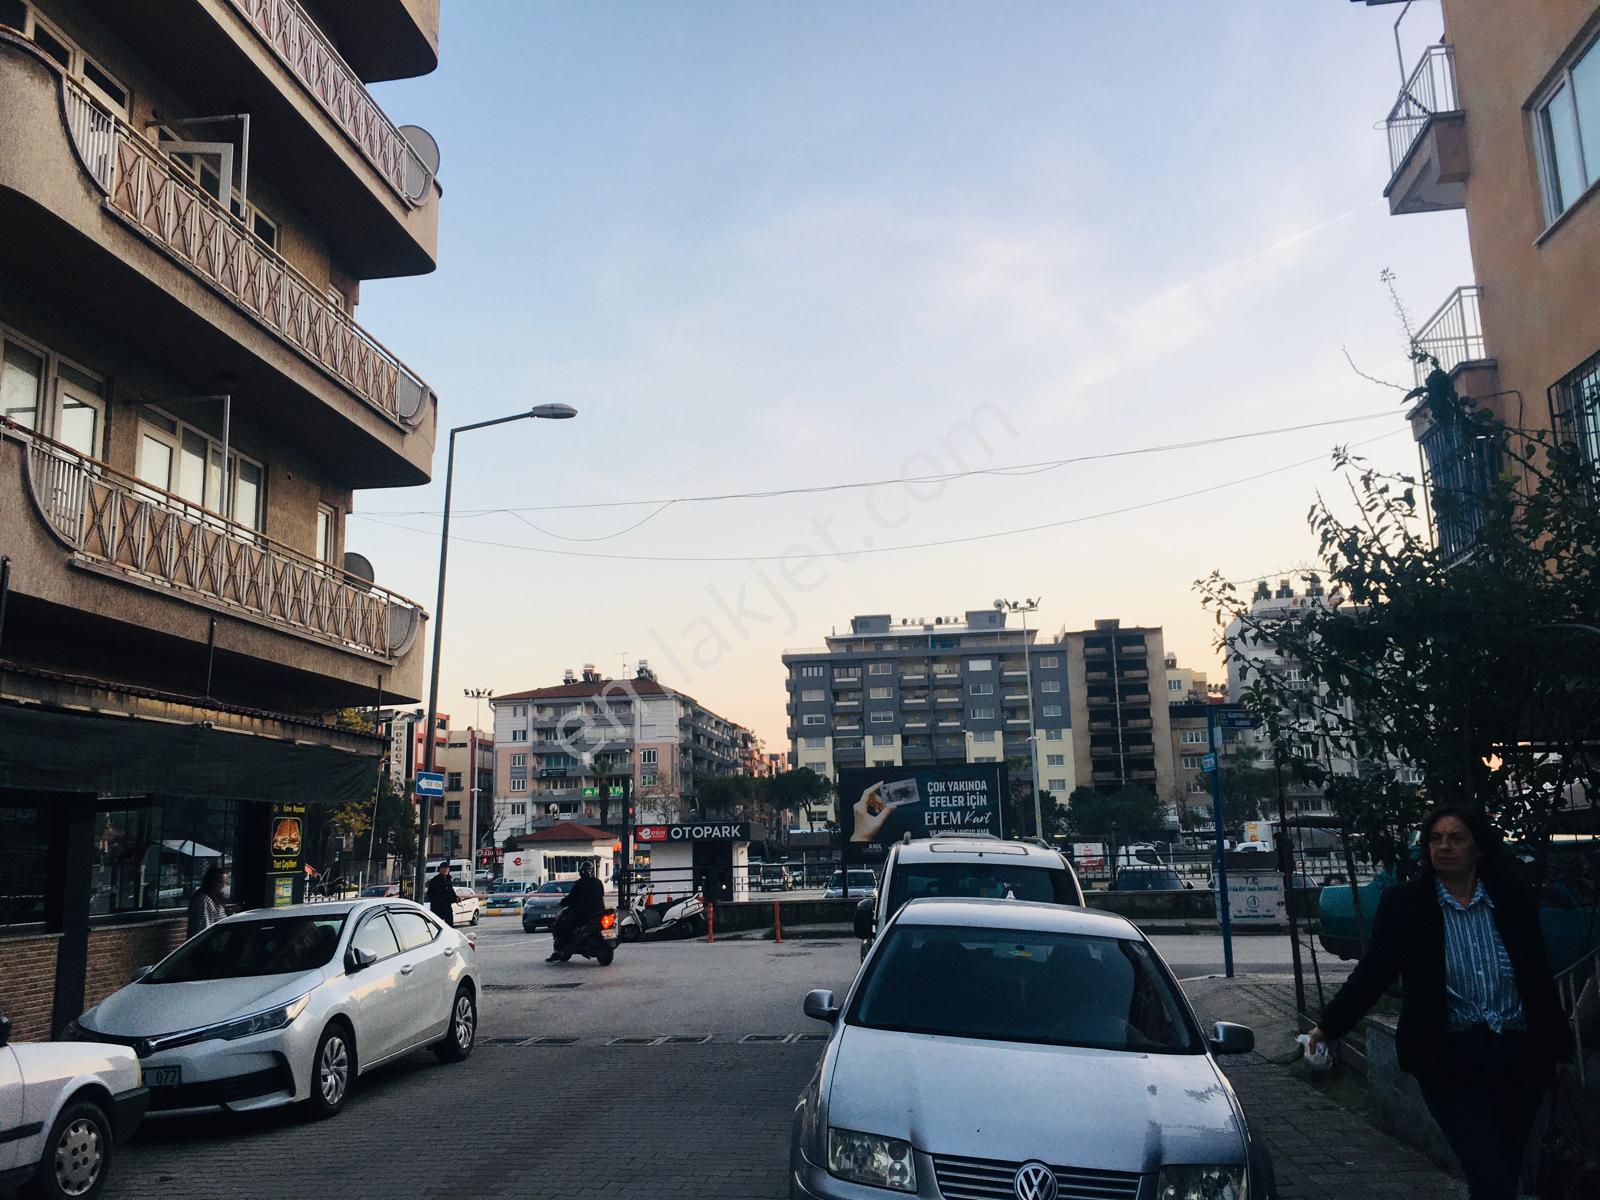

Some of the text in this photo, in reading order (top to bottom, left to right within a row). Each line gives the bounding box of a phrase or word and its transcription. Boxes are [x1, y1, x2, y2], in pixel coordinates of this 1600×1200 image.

[927, 780, 988, 795] ÇOK YAKINDA
[929, 792, 988, 810] EFELER İÇİN
[924, 810, 993, 826] EFEM Kart
[671, 825, 741, 840] OTOPARK
[156, 1070, 178, 1085] 077
